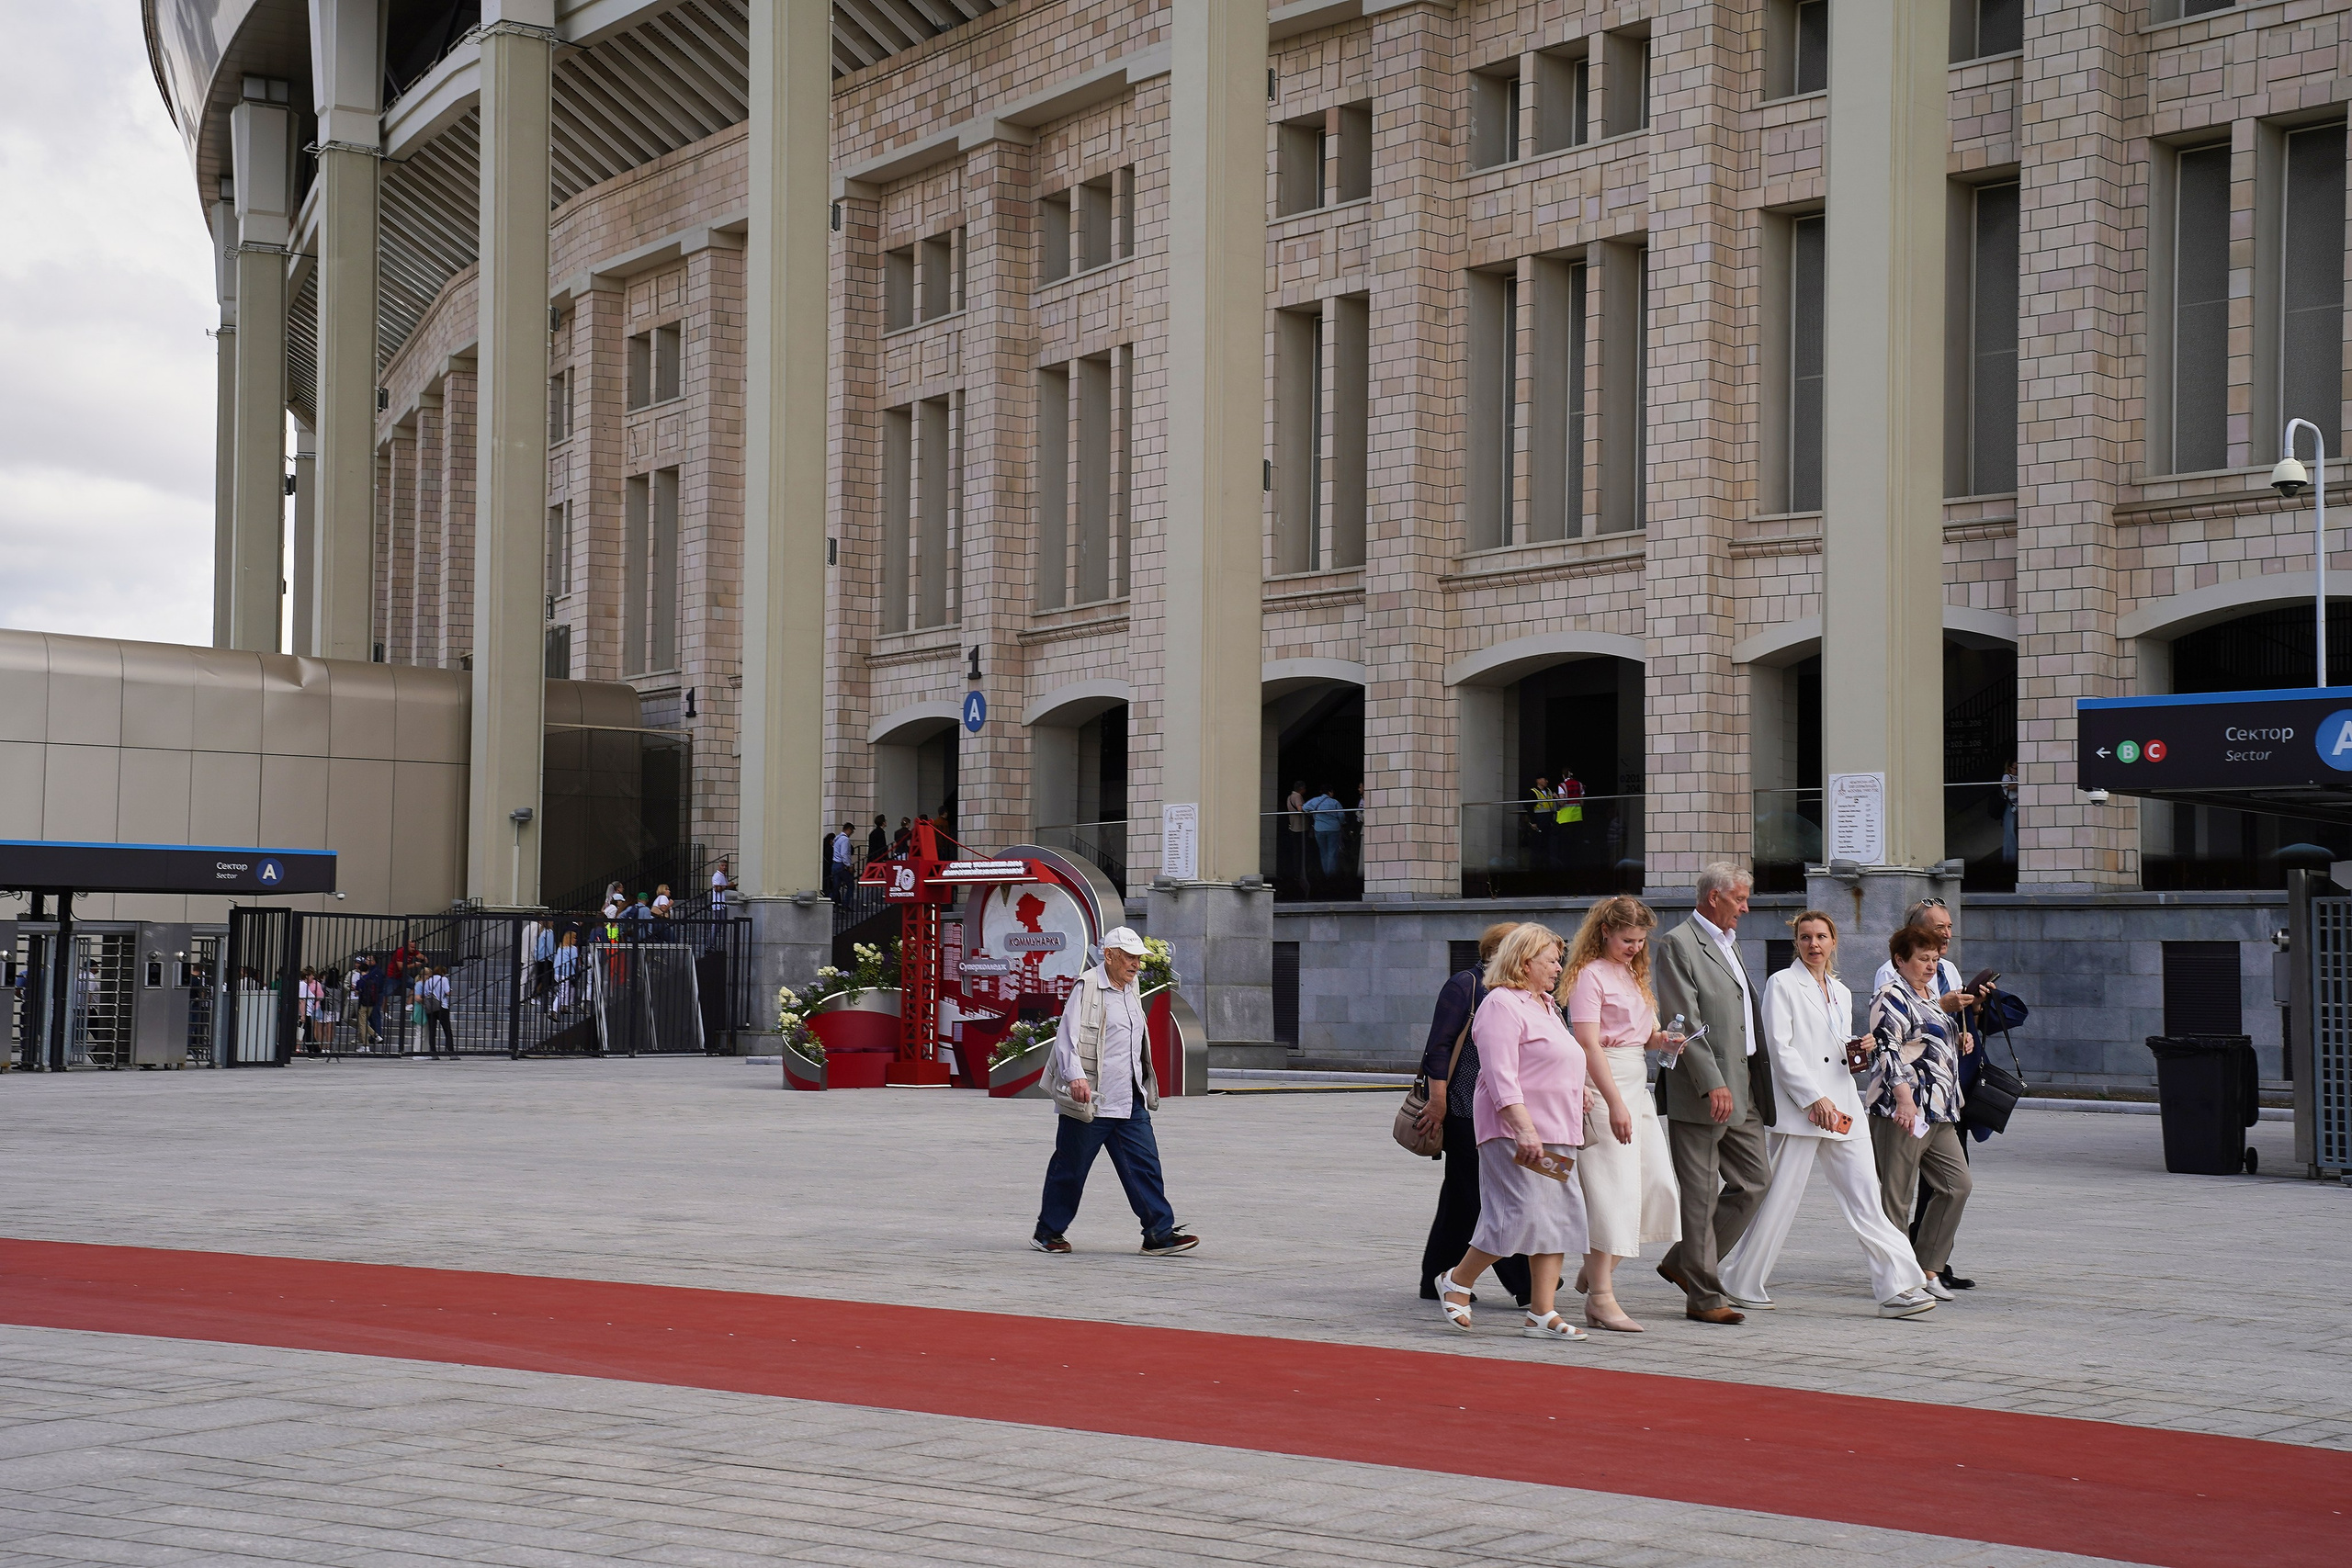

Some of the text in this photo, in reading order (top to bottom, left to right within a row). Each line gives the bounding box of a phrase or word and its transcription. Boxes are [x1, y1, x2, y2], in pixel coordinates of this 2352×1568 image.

[967, 645, 982, 680] 1
[685, 687, 696, 718] 1
[967, 698, 981, 722] A
[2225, 727, 2295, 743] Сектор
[2122, 743, 2160, 760] B C
[2225, 750, 2272, 761] Sector
[216, 862, 248, 872] Сектор
[262, 863, 277, 880] A
[892, 865, 916, 890] 70
[1009, 937, 1061, 947] КОММУНАРКА
[958, 962, 1008, 972] Суперколледж
